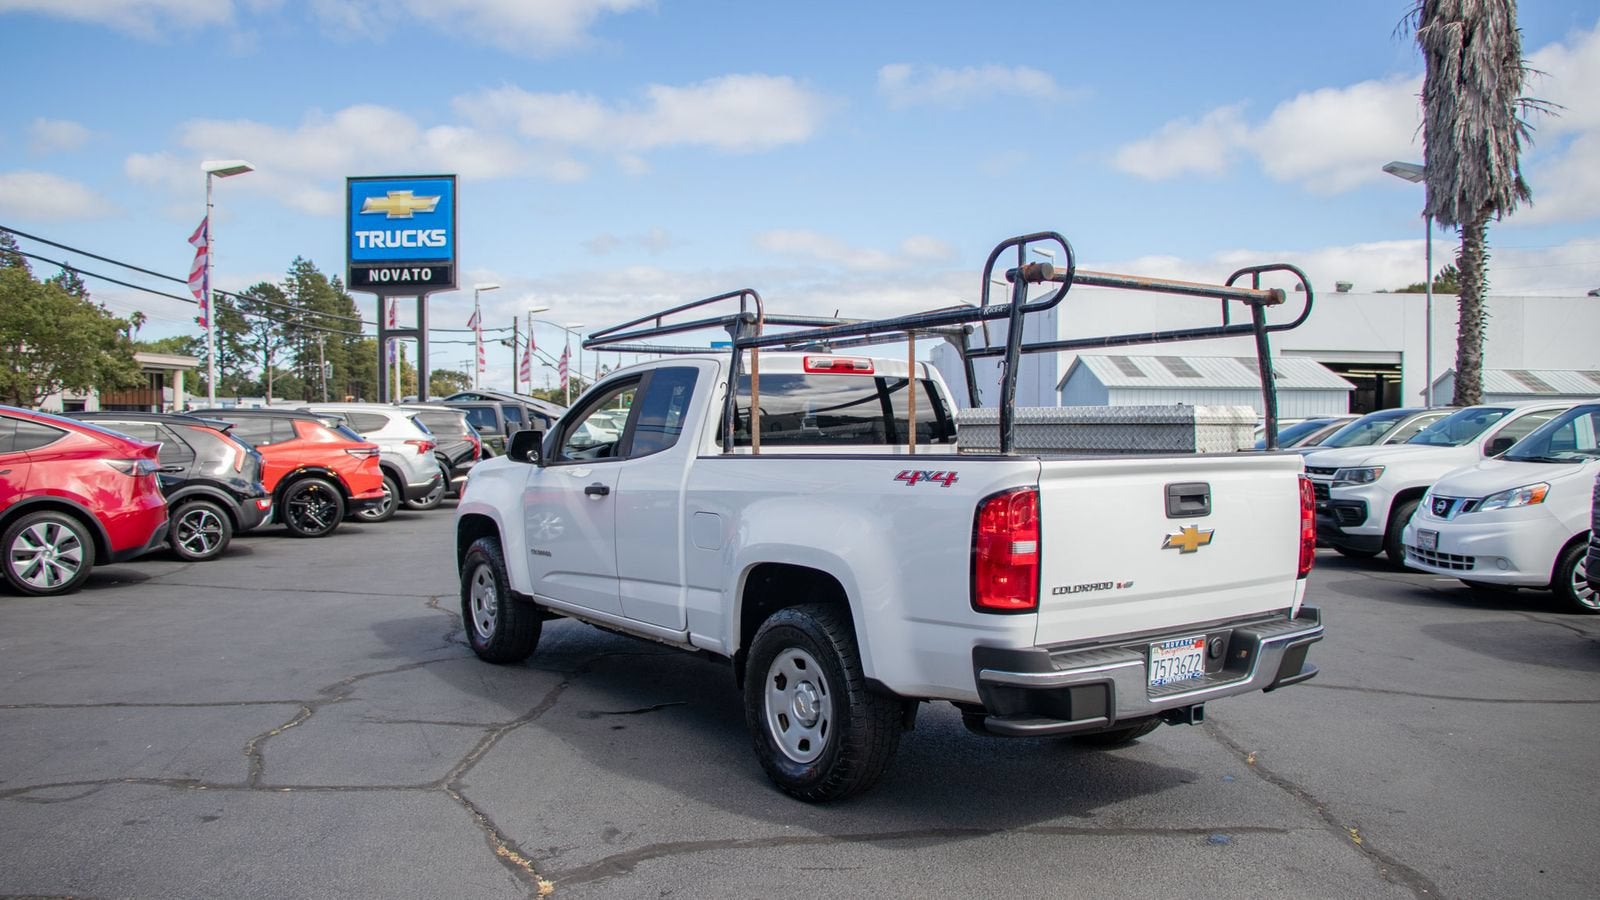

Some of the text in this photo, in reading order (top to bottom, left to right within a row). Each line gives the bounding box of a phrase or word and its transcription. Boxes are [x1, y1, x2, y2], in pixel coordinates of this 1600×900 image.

[355, 229, 447, 249] TRUCKS
[369, 268, 432, 282] NOVATO
[1052, 581, 1114, 596] COLORADO
[1165, 639, 1193, 649] NOVATO
